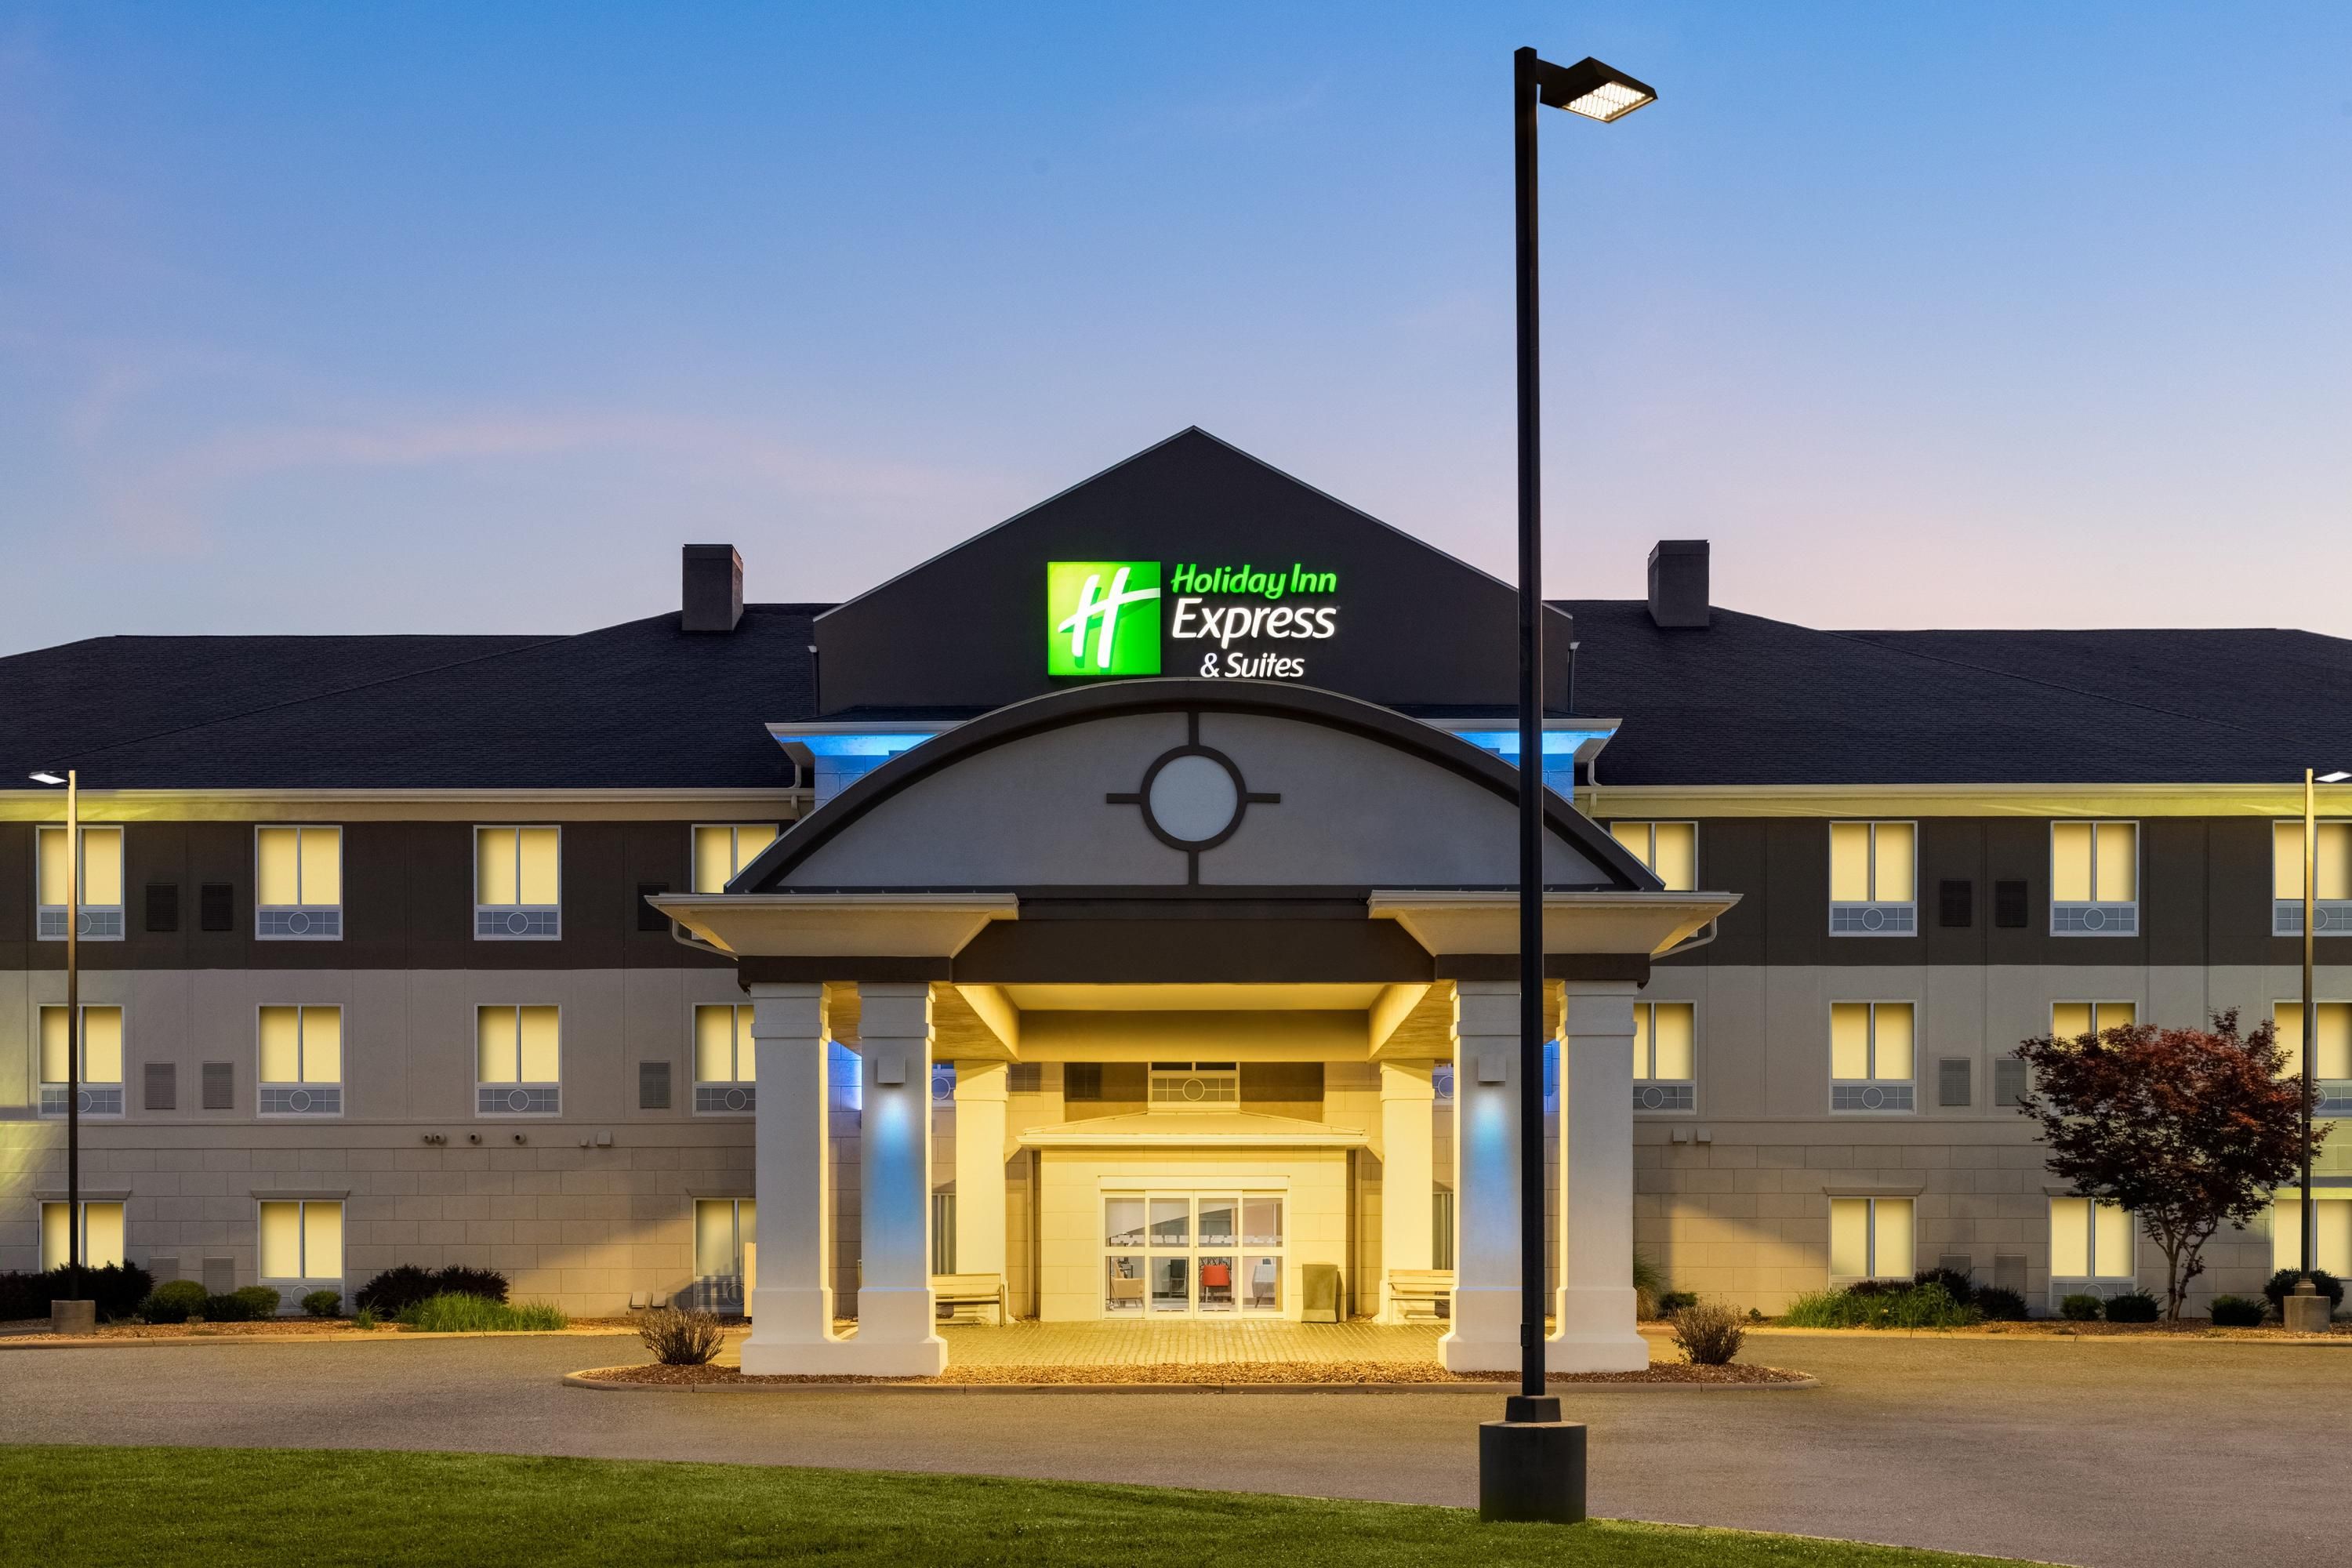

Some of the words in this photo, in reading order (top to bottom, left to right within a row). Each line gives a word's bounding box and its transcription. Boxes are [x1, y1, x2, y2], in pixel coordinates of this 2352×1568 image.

[1171, 563, 1286, 599] Holiday
[1290, 564, 1337, 593] Inn
[1058, 567, 1160, 668] H
[1171, 597, 1337, 649] Express
[1200, 652, 1220, 678] &
[1225, 653, 1305, 677] Suites
